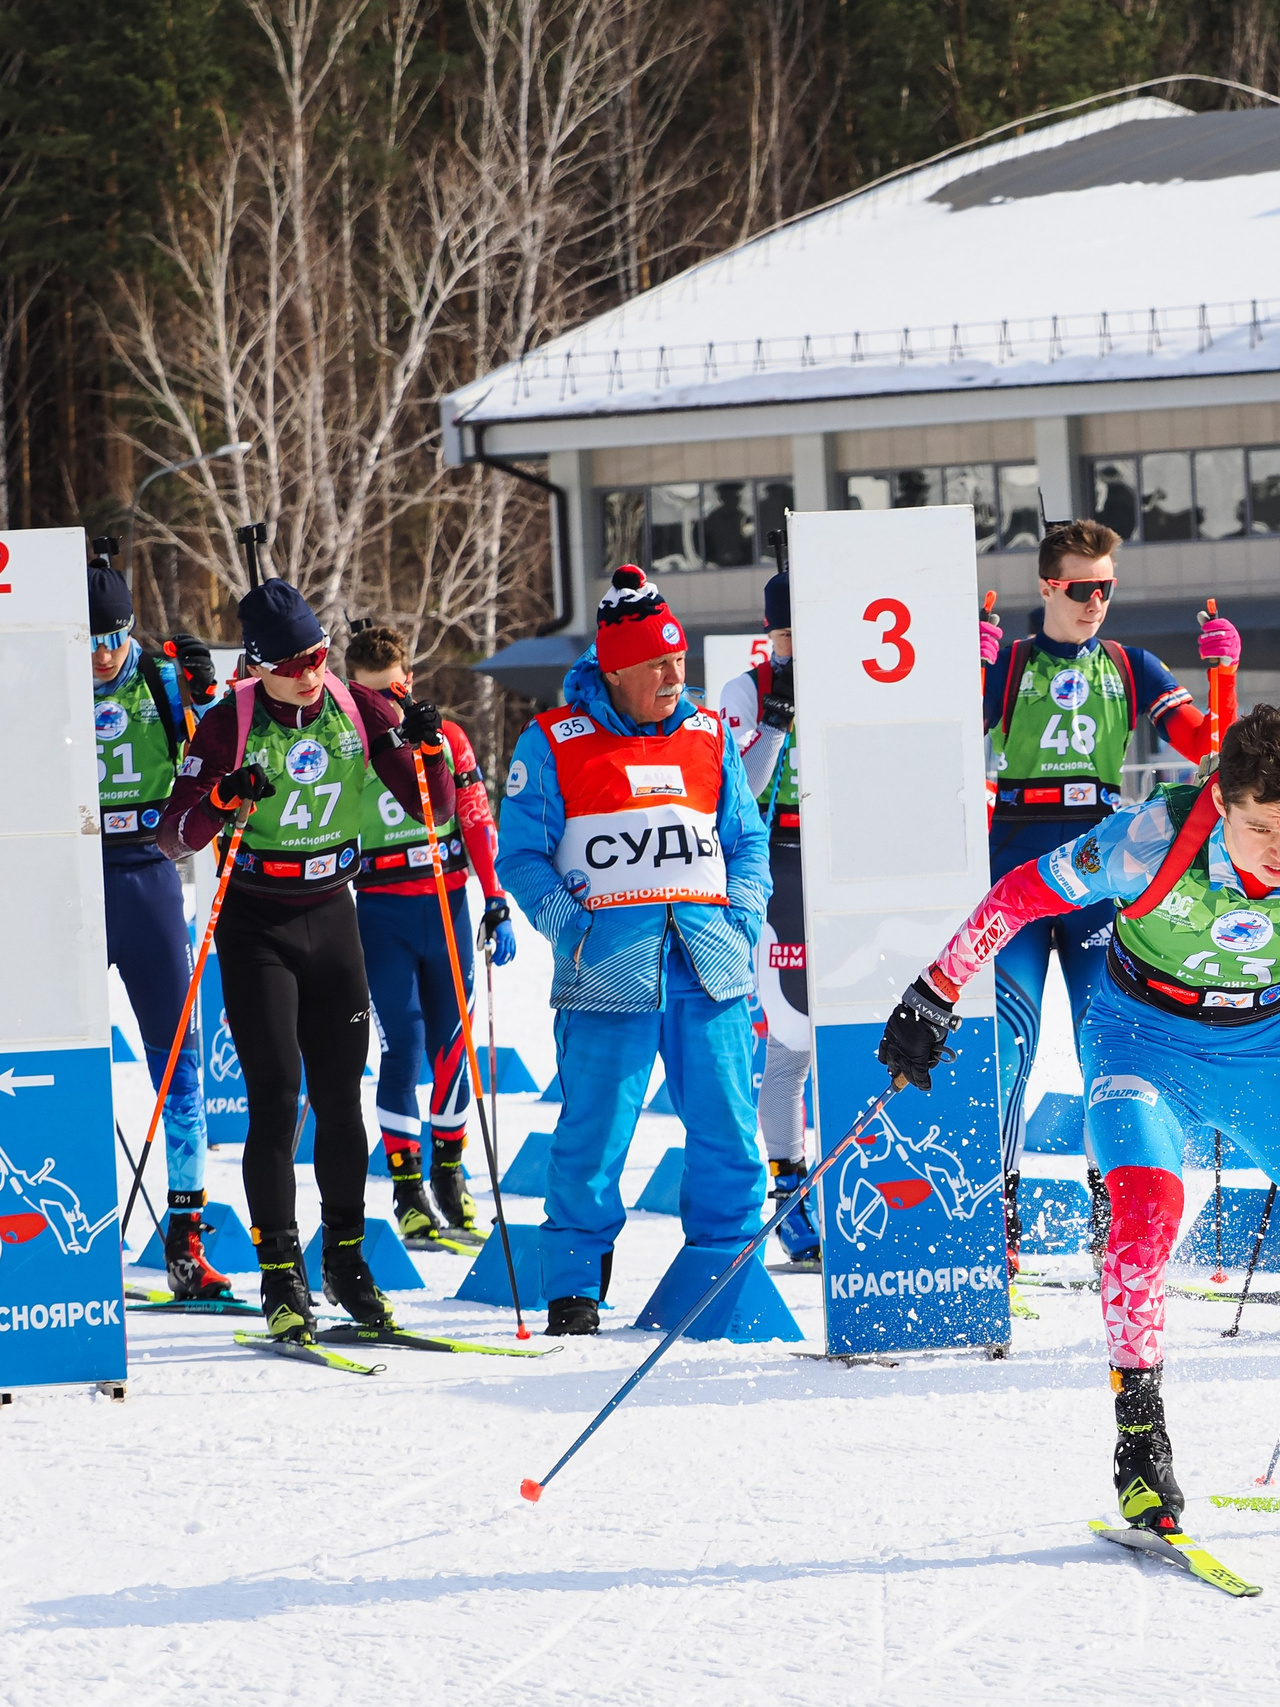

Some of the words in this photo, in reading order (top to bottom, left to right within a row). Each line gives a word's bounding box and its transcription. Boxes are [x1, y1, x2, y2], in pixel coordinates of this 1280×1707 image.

[861, 597, 916, 684] 3
[558, 719, 586, 737] 35
[690, 714, 713, 731] 35
[1040, 713, 1097, 755] 48
[1040, 761, 1096, 772] КРАСНОЯРС
[98, 788, 141, 801] СНОЯРСК
[279, 781, 343, 830] 47
[280, 830, 342, 847] КРАСНОЯРСК
[384, 826, 429, 841] КРАСНОЯР
[772, 945, 803, 957] BIV
[771, 956, 803, 967] IUM
[1106, 1089, 1154, 1103] GAZPROM
[174, 1195, 191, 1204] 201
[830, 1264, 1004, 1300] КРАСНОЯРСК
[0, 1298, 121, 1332] СНОЯРСК
